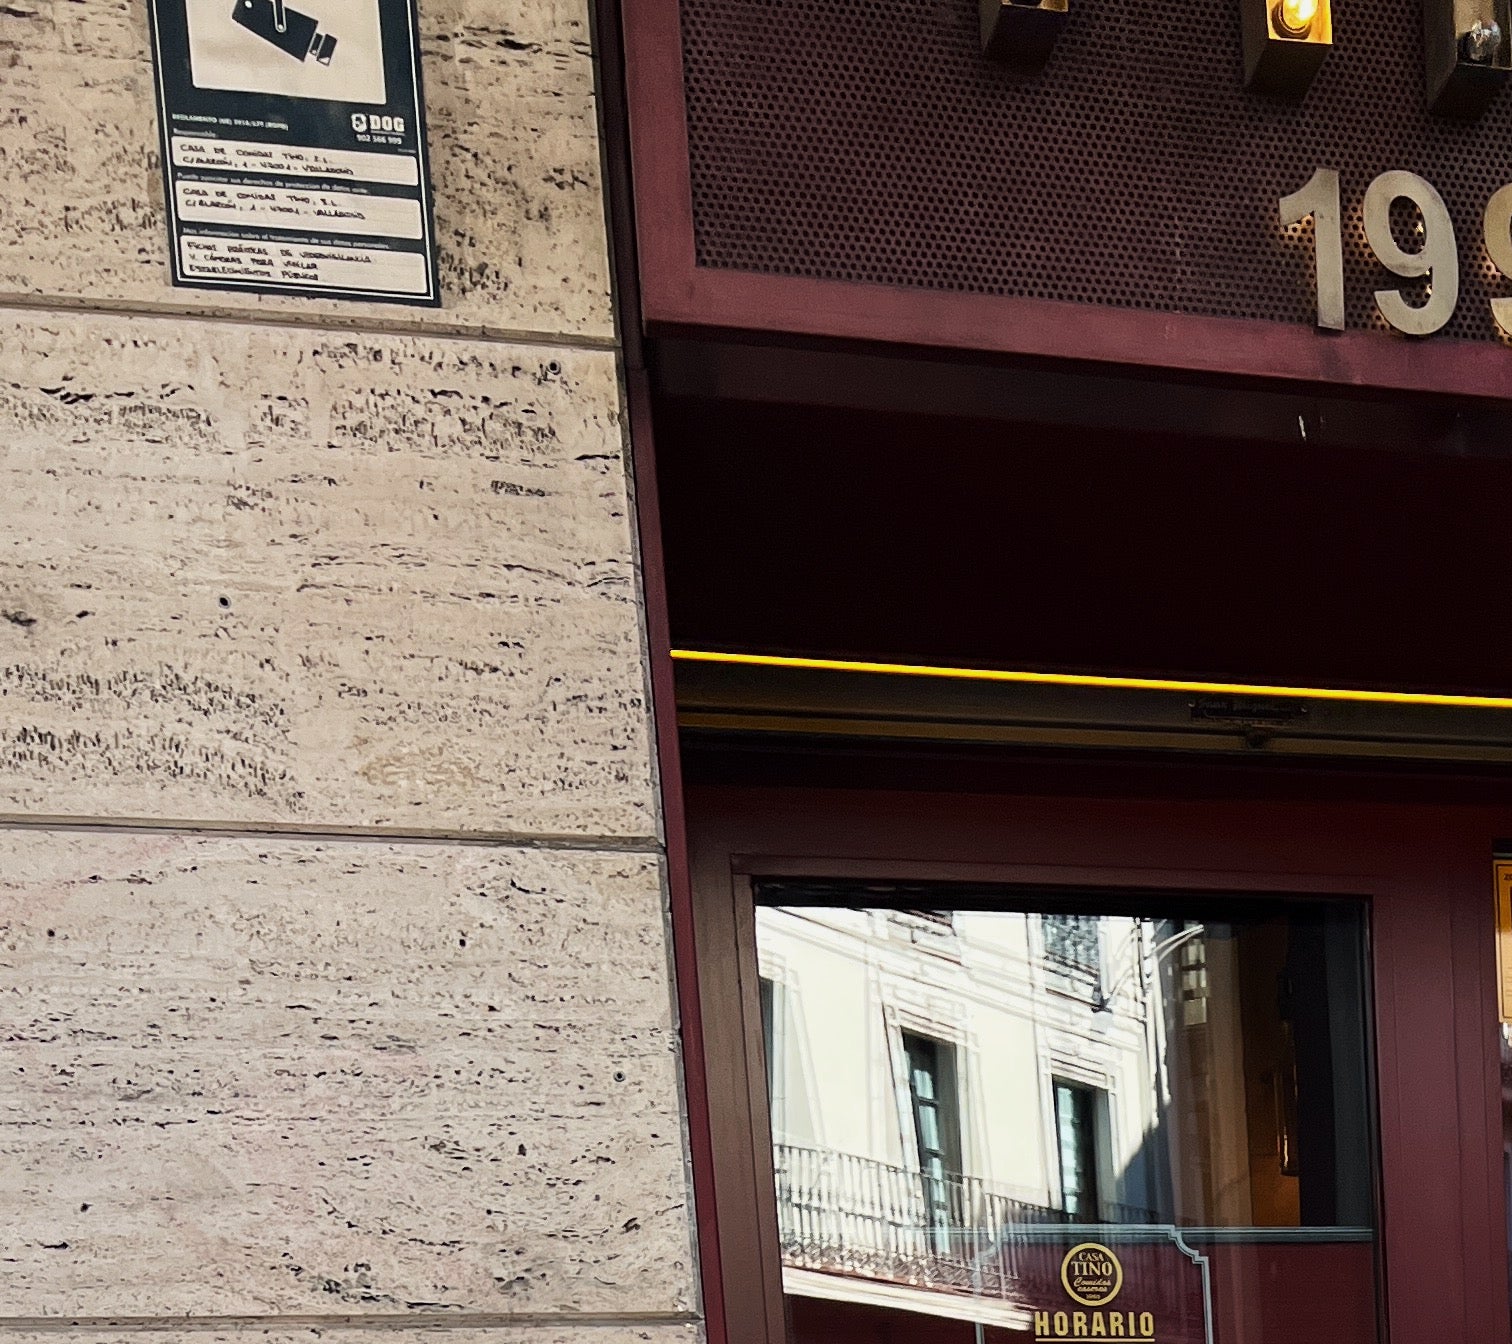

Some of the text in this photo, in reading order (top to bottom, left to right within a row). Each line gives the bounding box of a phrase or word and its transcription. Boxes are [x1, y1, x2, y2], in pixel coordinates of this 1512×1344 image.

[370, 115, 405, 132] DOG
[1079, 1252, 1104, 1261] CASA
[1071, 1261, 1113, 1276] TINO
[1034, 1311, 1154, 1336] HORARIO
